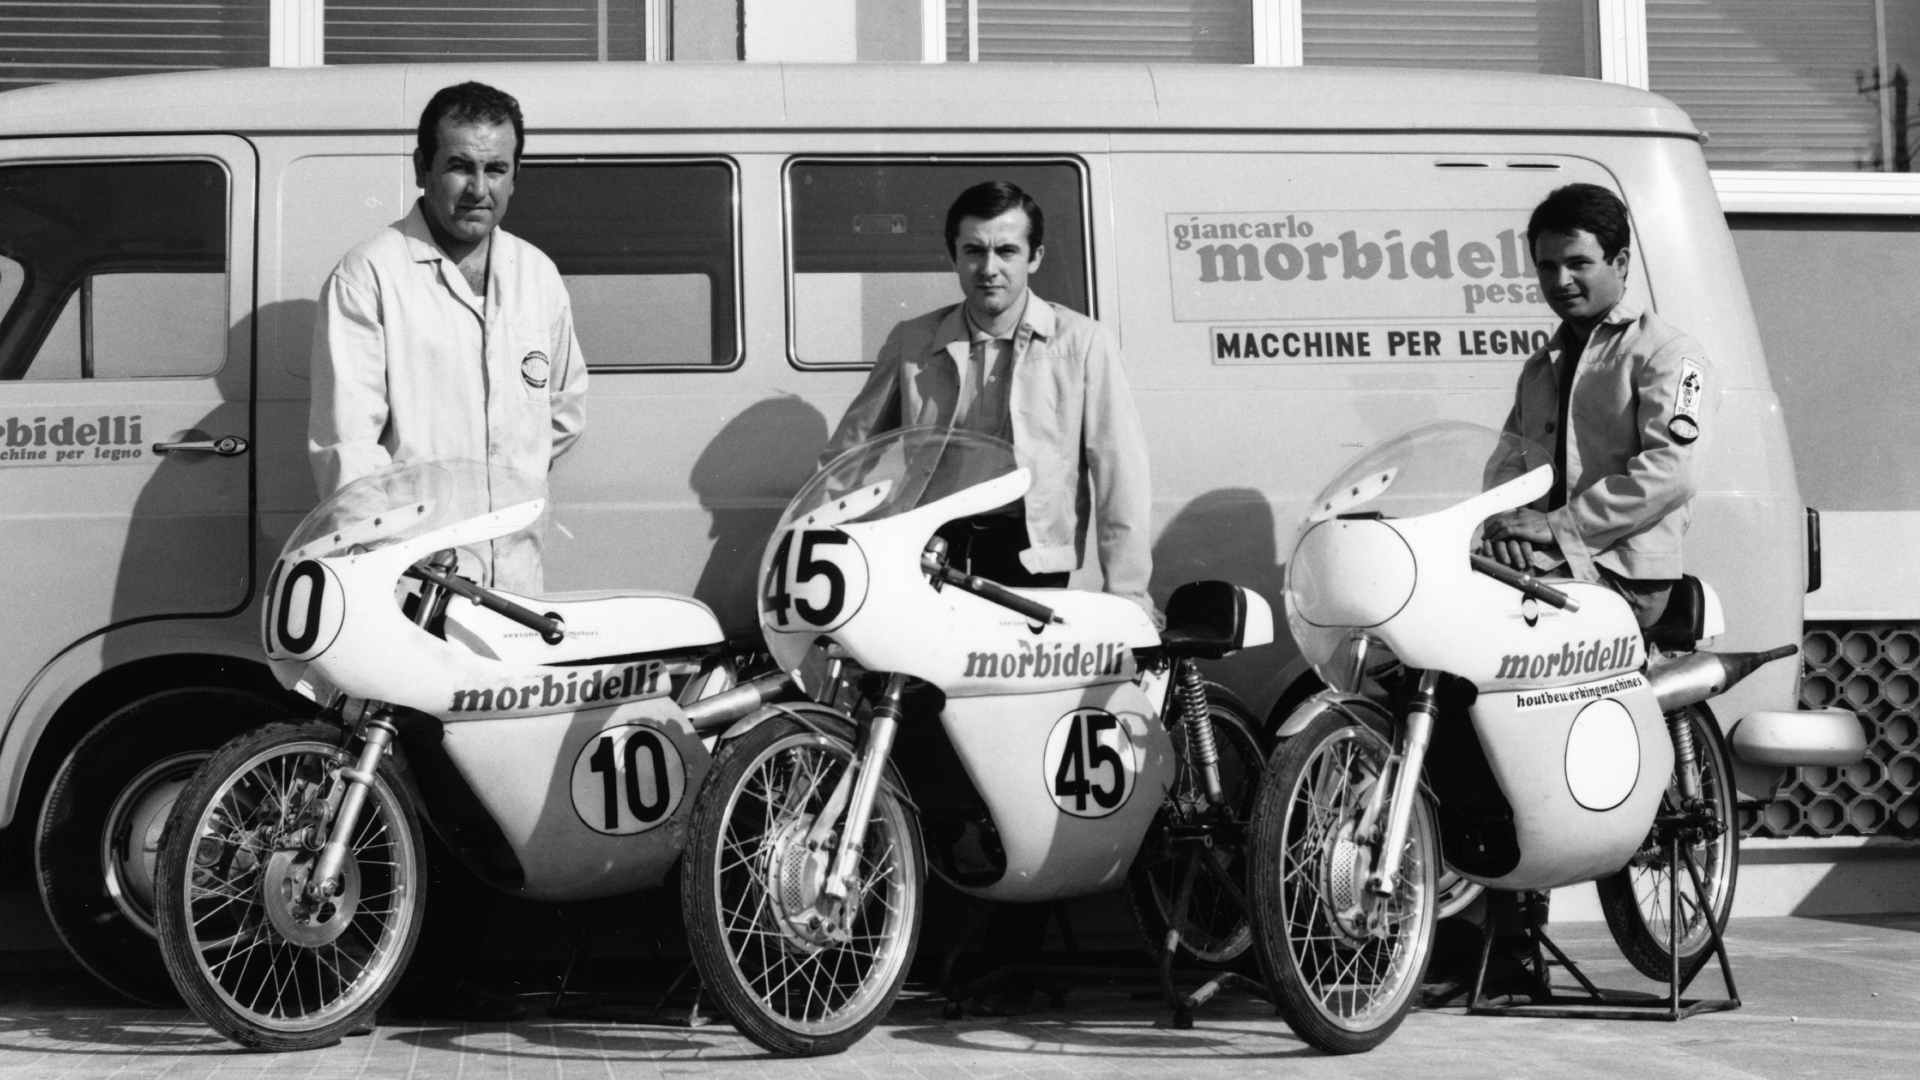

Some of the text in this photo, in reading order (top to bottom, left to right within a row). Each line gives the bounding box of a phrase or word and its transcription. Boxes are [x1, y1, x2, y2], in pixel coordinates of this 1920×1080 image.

[1173, 215, 1314, 250] giancarlo
[1196, 229, 1539, 282] morbidell
[1462, 283, 1547, 314] pesa
[1217, 330, 1550, 359] MACCHINE PER LEGNO
[0, 447, 142, 462] chine per legno
[762, 529, 850, 627] 45
[568, 629, 599, 637] motori
[963, 642, 1125, 678] morbidelli
[1495, 635, 1637, 679] morbidelli
[449, 661, 661, 712] morbidelli
[1516, 676, 1643, 709] houtbewerkingmachines
[590, 730, 671, 830] 10
[1055, 714, 1125, 811] 45
